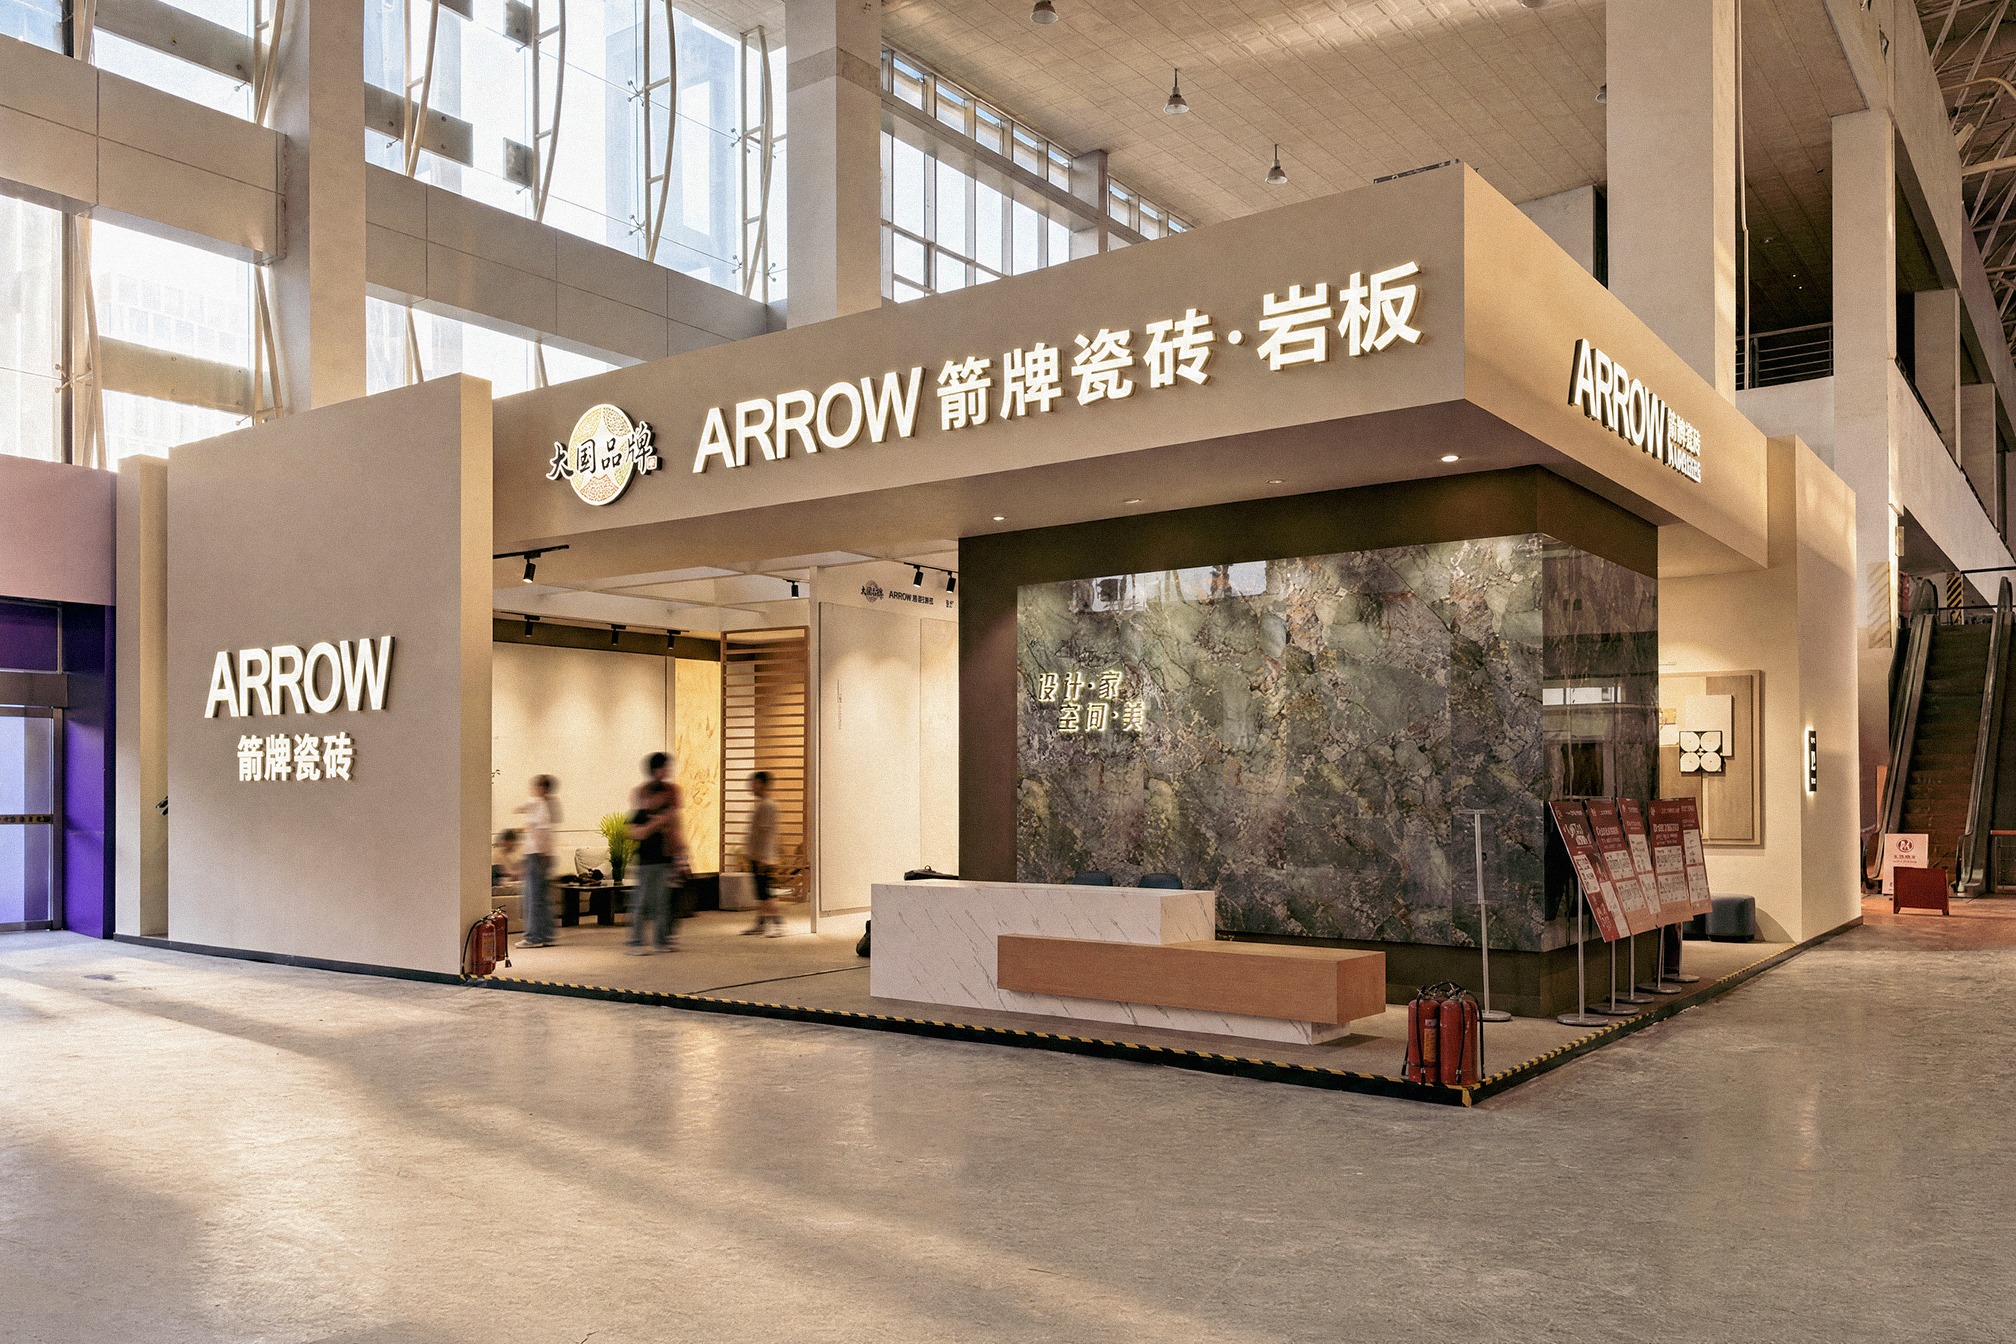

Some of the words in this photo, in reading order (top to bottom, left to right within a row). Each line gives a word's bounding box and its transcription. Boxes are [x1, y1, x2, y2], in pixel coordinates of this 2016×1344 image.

[692, 366, 925, 474] ARROW
[1572, 337, 1666, 460] ARROW
[547, 421, 652, 480] 大国品牌
[204, 635, 394, 719] ARROW
[237, 731, 354, 782] 箭牌瓷砖
